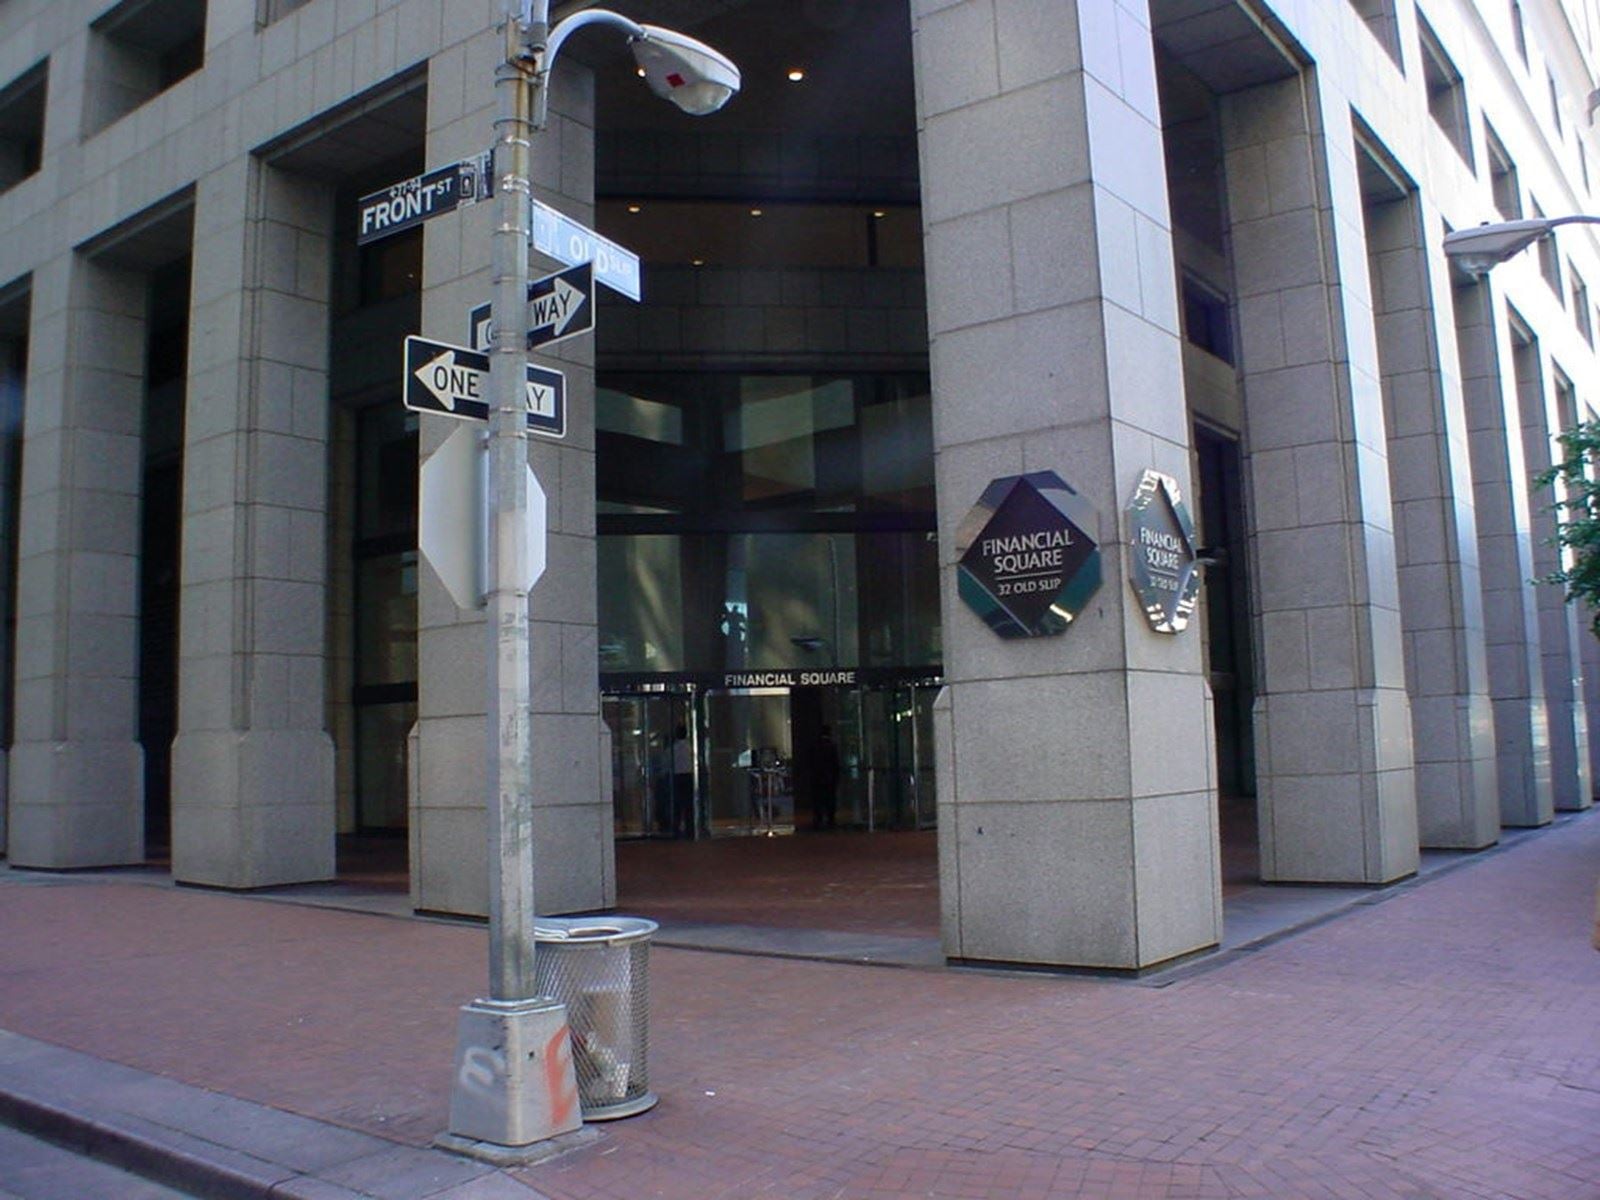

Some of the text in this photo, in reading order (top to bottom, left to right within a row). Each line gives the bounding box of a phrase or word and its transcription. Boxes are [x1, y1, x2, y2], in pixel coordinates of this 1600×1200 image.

[362, 185, 436, 235] FRONT
[437, 177, 453, 195] ST
[533, 290, 572, 325] WAY
[434, 365, 480, 398] ONE
[982, 529, 1075, 556] FINANCIAL
[1140, 526, 1182, 553] FINANCIAL
[994, 549, 1063, 573] SQUARE
[1146, 546, 1179, 570] SQUARE
[998, 577, 1061, 597] 32 OLD SLIP
[724, 671, 856, 686] FINANCIAL SQUARE
